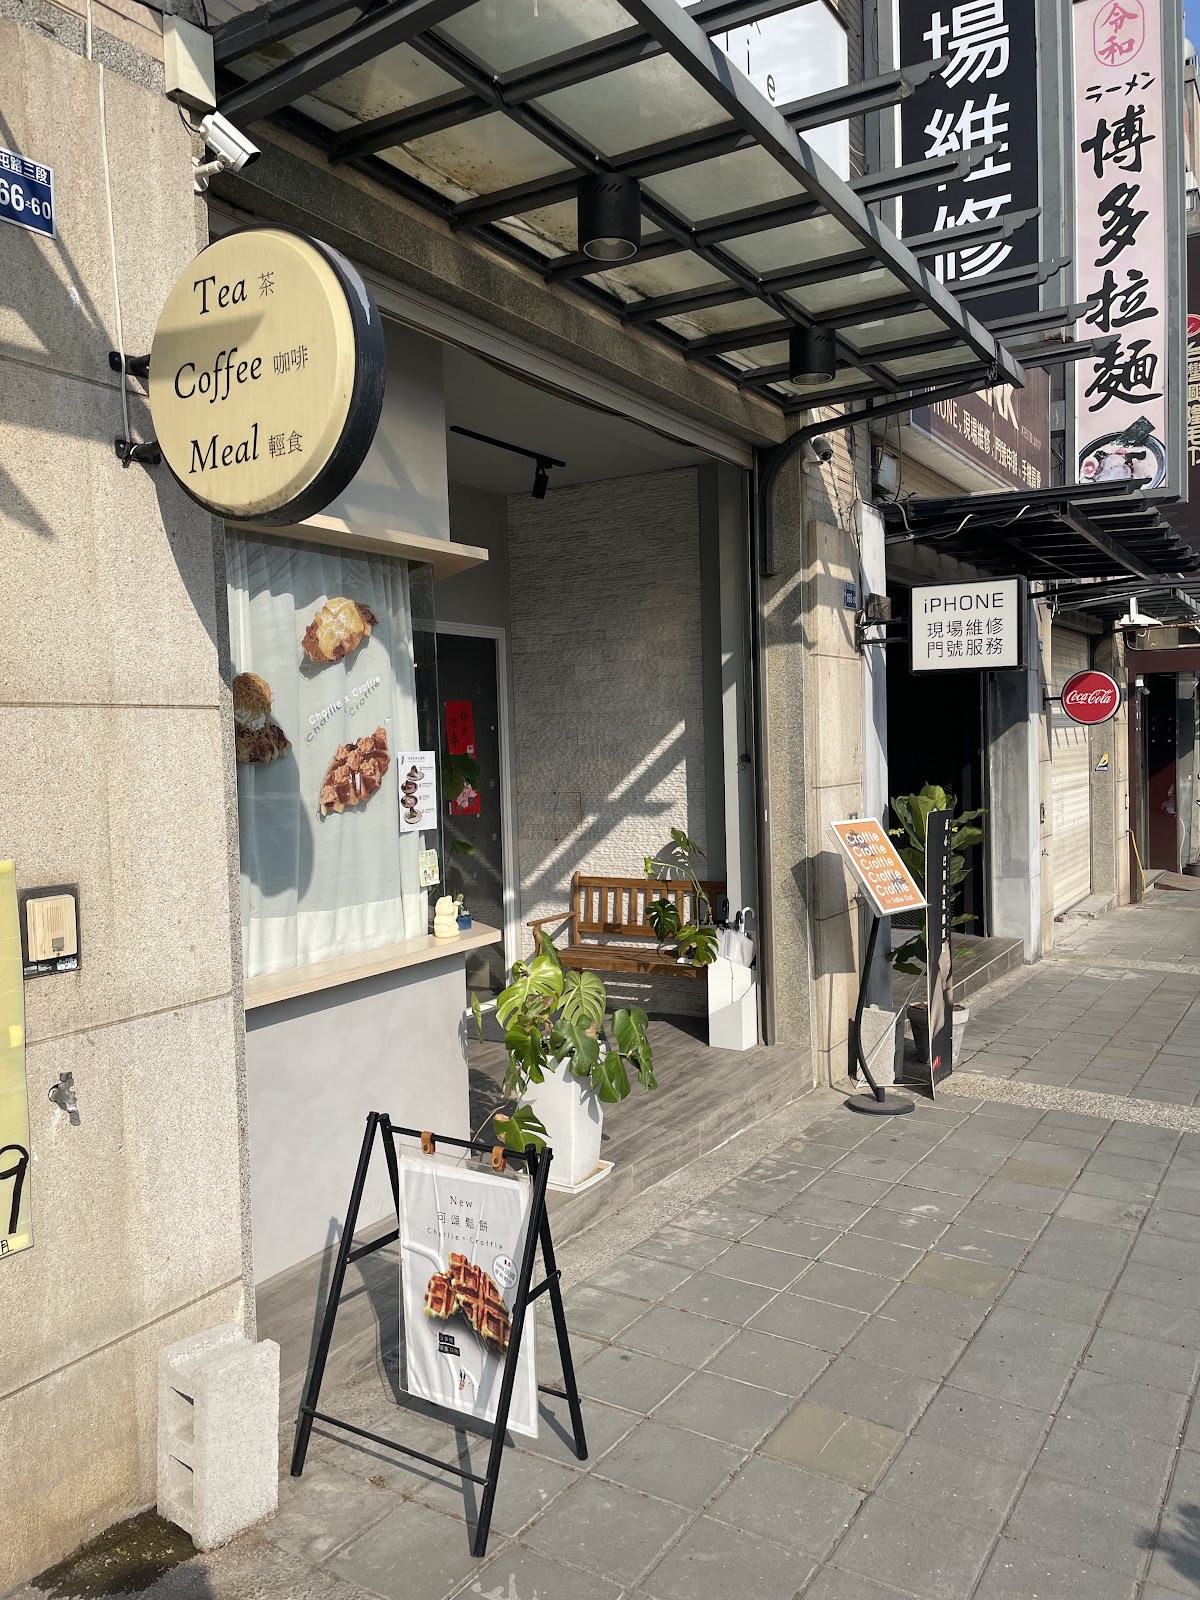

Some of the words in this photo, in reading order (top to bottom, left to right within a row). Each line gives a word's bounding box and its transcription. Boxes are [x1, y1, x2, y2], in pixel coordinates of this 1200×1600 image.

[1099, 2, 1139, 65] 令和
[1085, 71, 1156, 103] ラーメン
[193, 275, 248, 315] Tea
[258, 271, 275, 298] 茶
[174, 347, 262, 403] Coffee
[273, 345, 308, 375] 咖啡
[188, 422, 259, 474] Meal
[268, 430, 303, 458] 輕食
[923, 592, 1004, 614] iPHONE
[927, 617, 1003, 639] 現場維修
[927, 637, 1003, 659] 門號服務
[308, 700, 342, 725] Charlie
[352, 675, 380, 697] Croffle
[845, 831, 880, 845] Croffle
[852, 844, 887, 858] Croffle
[860, 856, 895, 870] Croffle
[868, 869, 902, 883] Croffle
[876, 881, 910, 897] Croffle
[450, 1195, 473, 1208] New
[469, 1236, 503, 1250] Croffle
